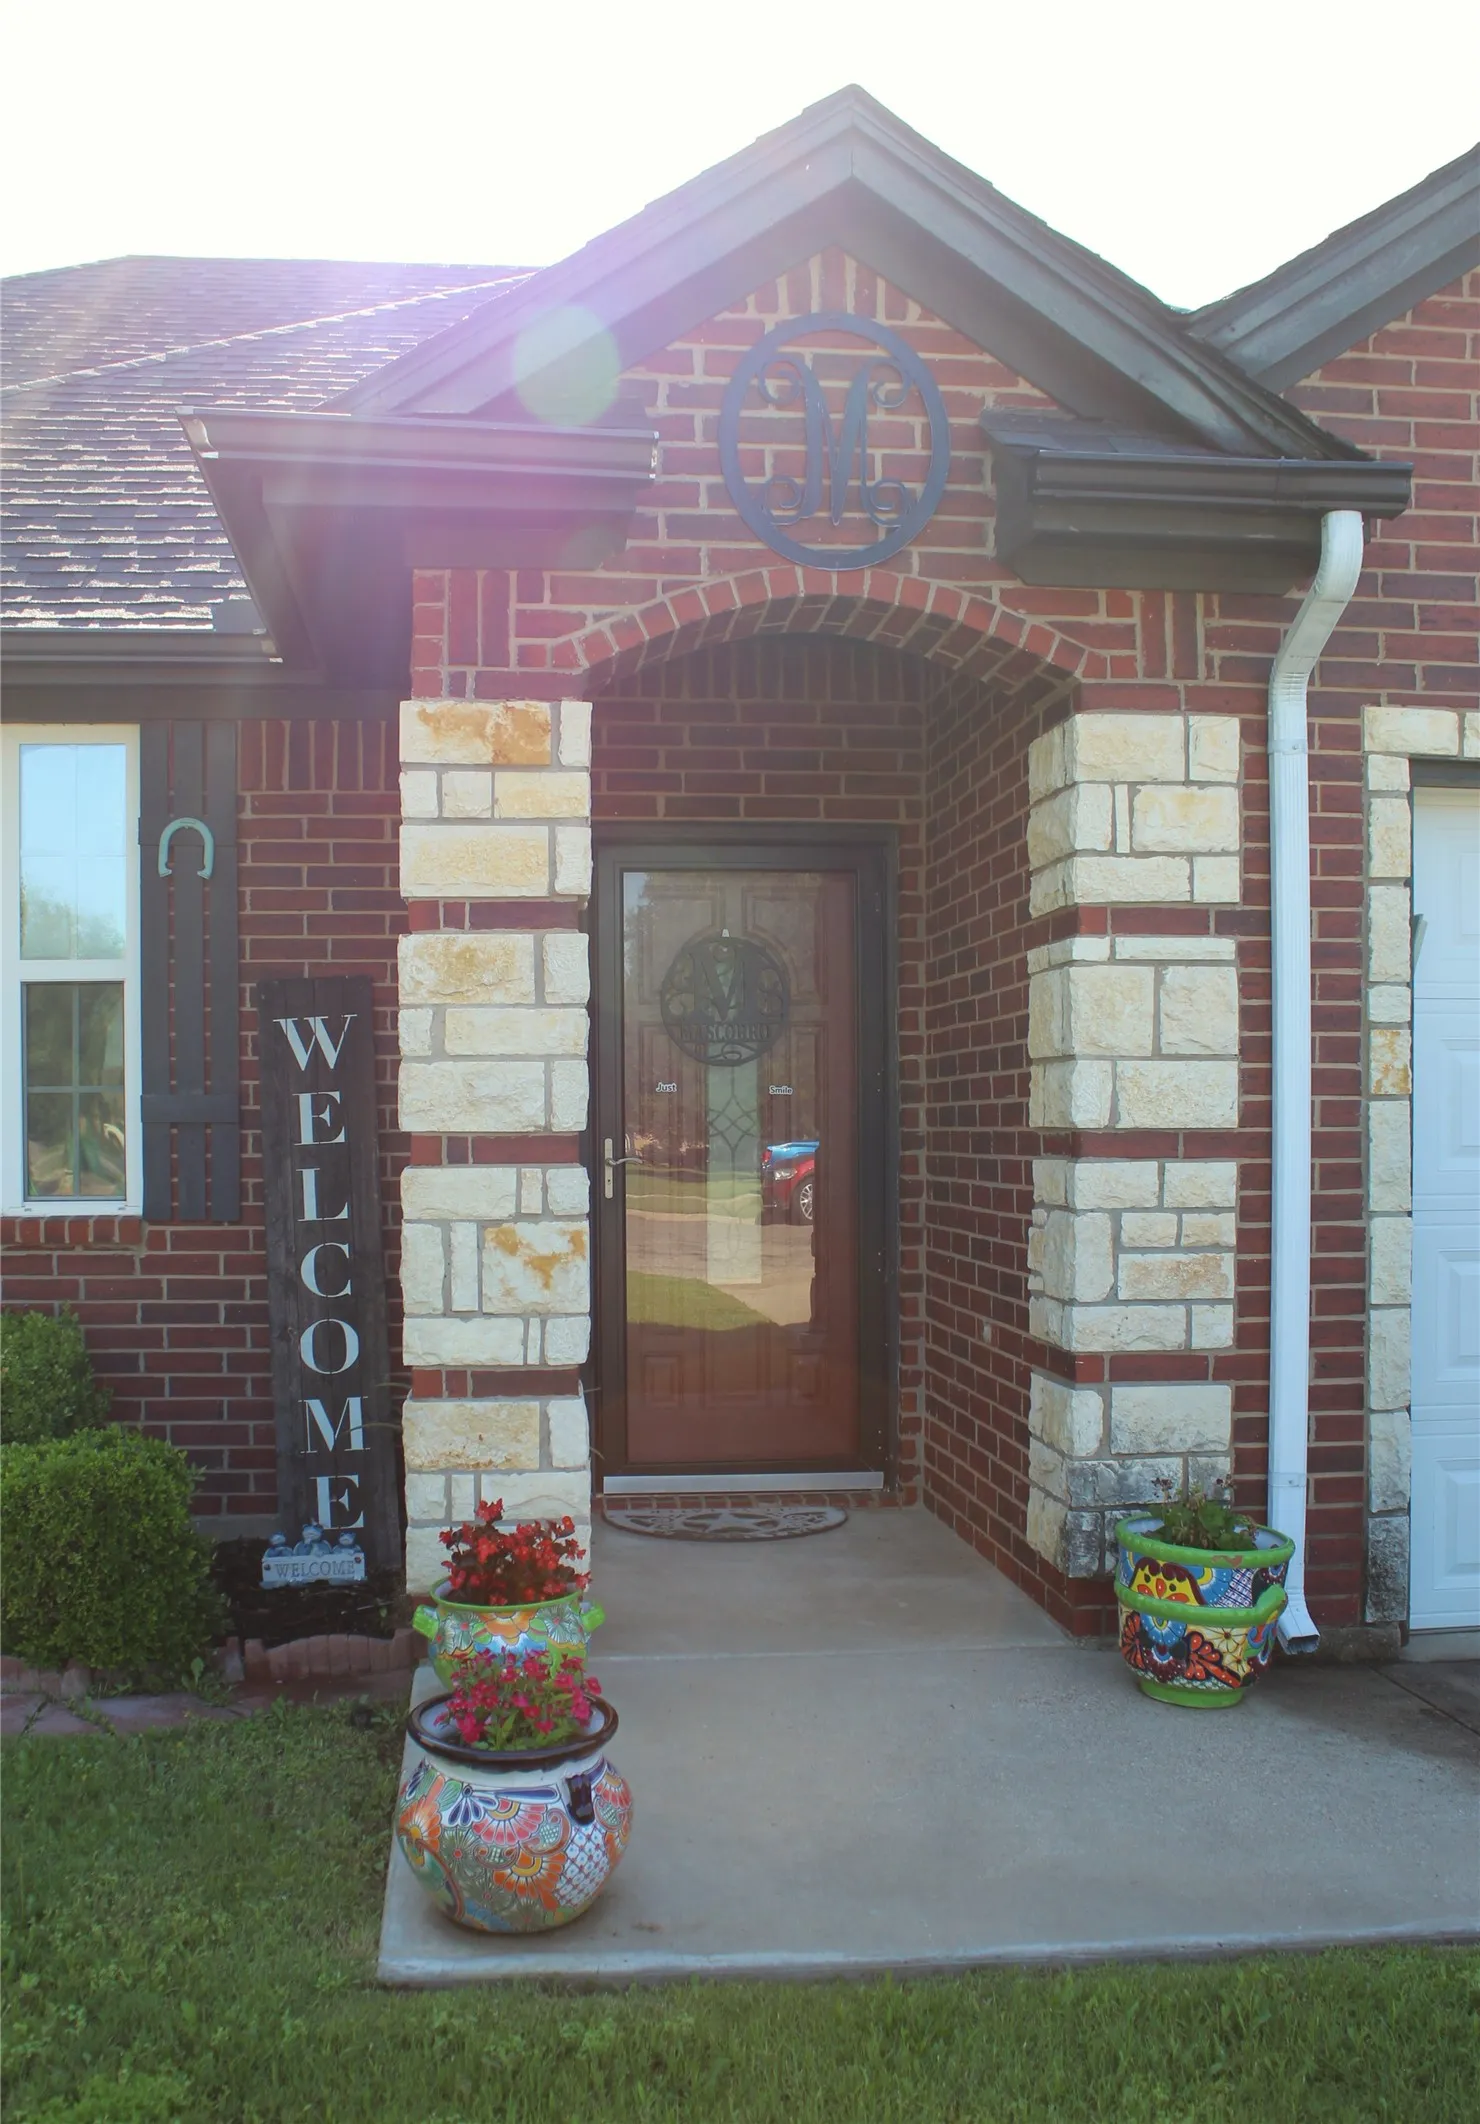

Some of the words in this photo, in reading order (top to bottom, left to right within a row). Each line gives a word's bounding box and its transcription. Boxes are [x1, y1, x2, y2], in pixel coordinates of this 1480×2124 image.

[757, 356, 914, 527] M
[689, 944, 760, 1021] M
[656, 1082, 677, 1092] Just
[769, 1085, 793, 1095] Smile
[273, 1014, 370, 1530] WELCOME
[276, 1561, 355, 1577] WELCOME
